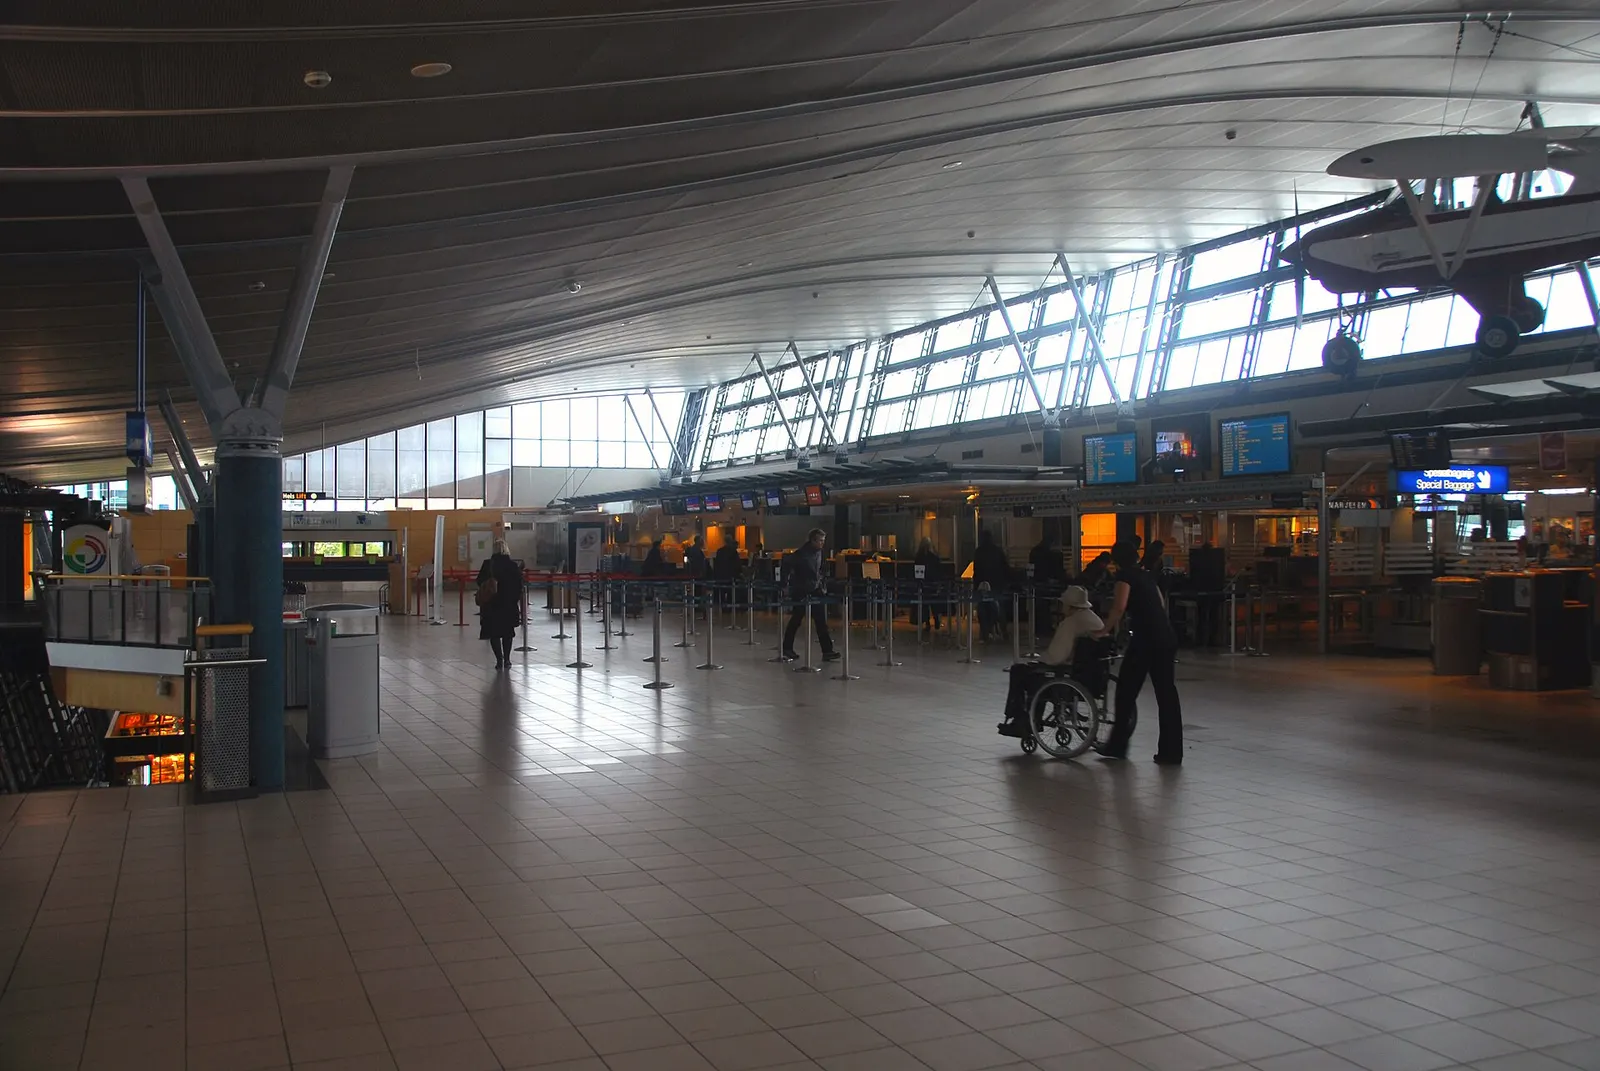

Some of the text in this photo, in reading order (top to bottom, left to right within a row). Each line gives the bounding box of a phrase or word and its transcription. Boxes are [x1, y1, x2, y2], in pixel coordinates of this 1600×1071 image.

[1416, 479, 1475, 491] Special Baggage
[296, 492, 307, 500] Lift
